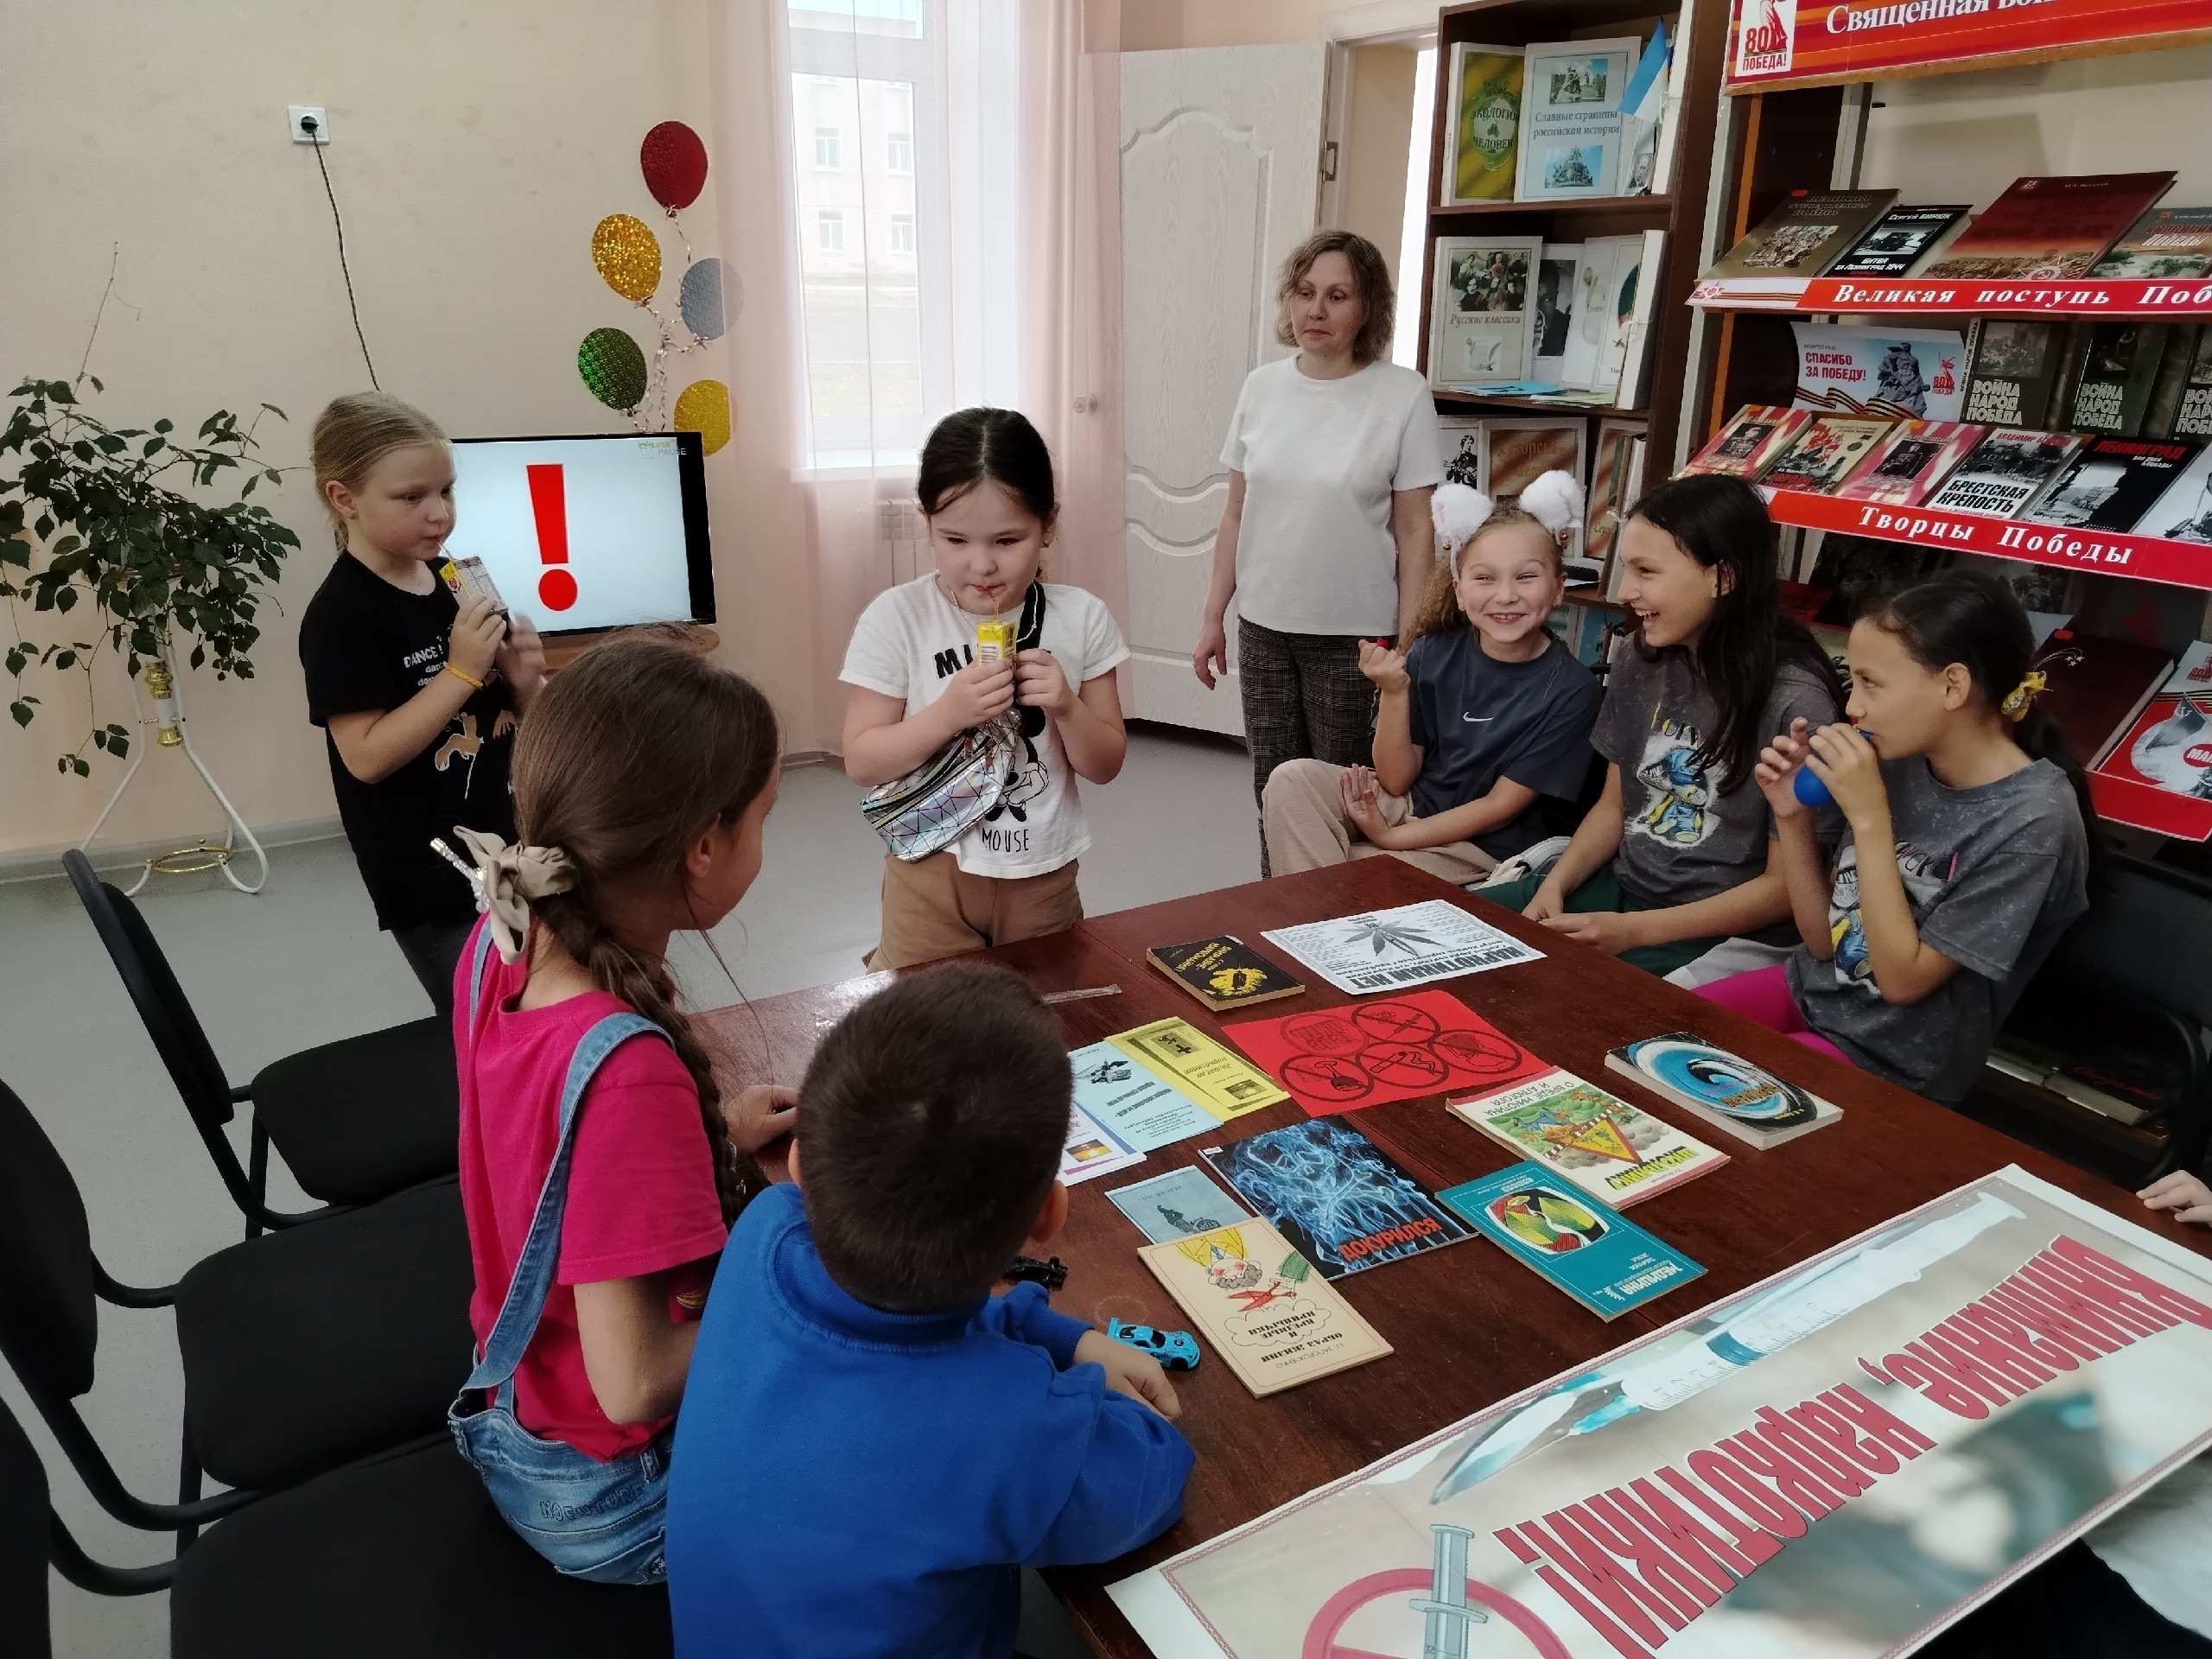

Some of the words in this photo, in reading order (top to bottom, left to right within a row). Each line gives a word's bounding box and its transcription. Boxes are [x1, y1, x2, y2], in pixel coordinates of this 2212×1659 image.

[1827, 0, 1989, 34] Священная
[1745, 27, 1769, 53] 80
[1743, 54, 1787, 71] ПОБЕДА!
[1535, 111, 1573, 124] Славные
[1574, 110, 1618, 123] страницы
[1533, 126, 1582, 140] российской
[1583, 124, 1621, 136] истории
[2143, 233, 2210, 247] Победы
[1832, 284, 1955, 303] Великая
[1974, 289, 2111, 308] поступь
[1449, 314, 1483, 328] Русские
[1484, 315, 1522, 325] классики
[1805, 352, 1853, 365] СПАСИБО
[1805, 366, 1819, 378] ЗА
[1821, 367, 1867, 382] ПОБЕДУ!
[1973, 379, 2021, 397] ВОЙНА
[2081, 382, 2123, 401] ВОЙНА
[1969, 393, 2018, 411] НАРОД
[2077, 397, 2121, 415] НАРОД
[1966, 406, 2022, 425] ПОБЕДА
[2073, 410, 2123, 429] ПОБЕДА
[1995, 432, 2037, 443] ВЛАДИМИР
[658, 448, 687, 456] PAUSE
[2092, 440, 2188, 461] ЛЕНИНГРАД
[1947, 480, 2030, 499] БРЕСТСКАЯ
[1936, 492, 2015, 513] КРЕПОСТЬ
[1859, 505, 1976, 541] Творцы
[1996, 525, 2134, 565] Победы
[404, 645, 439, 669] DANCE
[982, 827, 1030, 853] MOUSE
[1382, 946, 1530, 982] НАРКОТИКАМ
[1344, 973, 1395, 990] НЕТ
[1488, 1085, 1541, 1106] АЛКОГОЛЯ
[1530, 1084, 1567, 1099] ВРЕДЕ
[1482, 1096, 1535, 1116] НИКОТИНА
[1599, 1145, 1700, 1191] ШКОЛЬНИКУ
[1338, 1217, 1444, 1263] ДОКУРИЛСЯ
[1616, 1261, 1684, 1297] МЕДИЦИНА
[1246, 1310, 1316, 1336] ПРИВЫЧКИ
[1258, 1317, 1315, 1339] ВРЕДНЫЕ
[1858, 1234, 2212, 1420] Внимание,
[1305, 1331, 1344, 1348] ОБРАЗ
[1259, 1344, 1306, 1363] ЖИЗНИ
[1274, 1344, 1334, 1369] ЗАПОРОЖЧЕНКО
[1492, 1381, 1939, 1659] наркотики!
